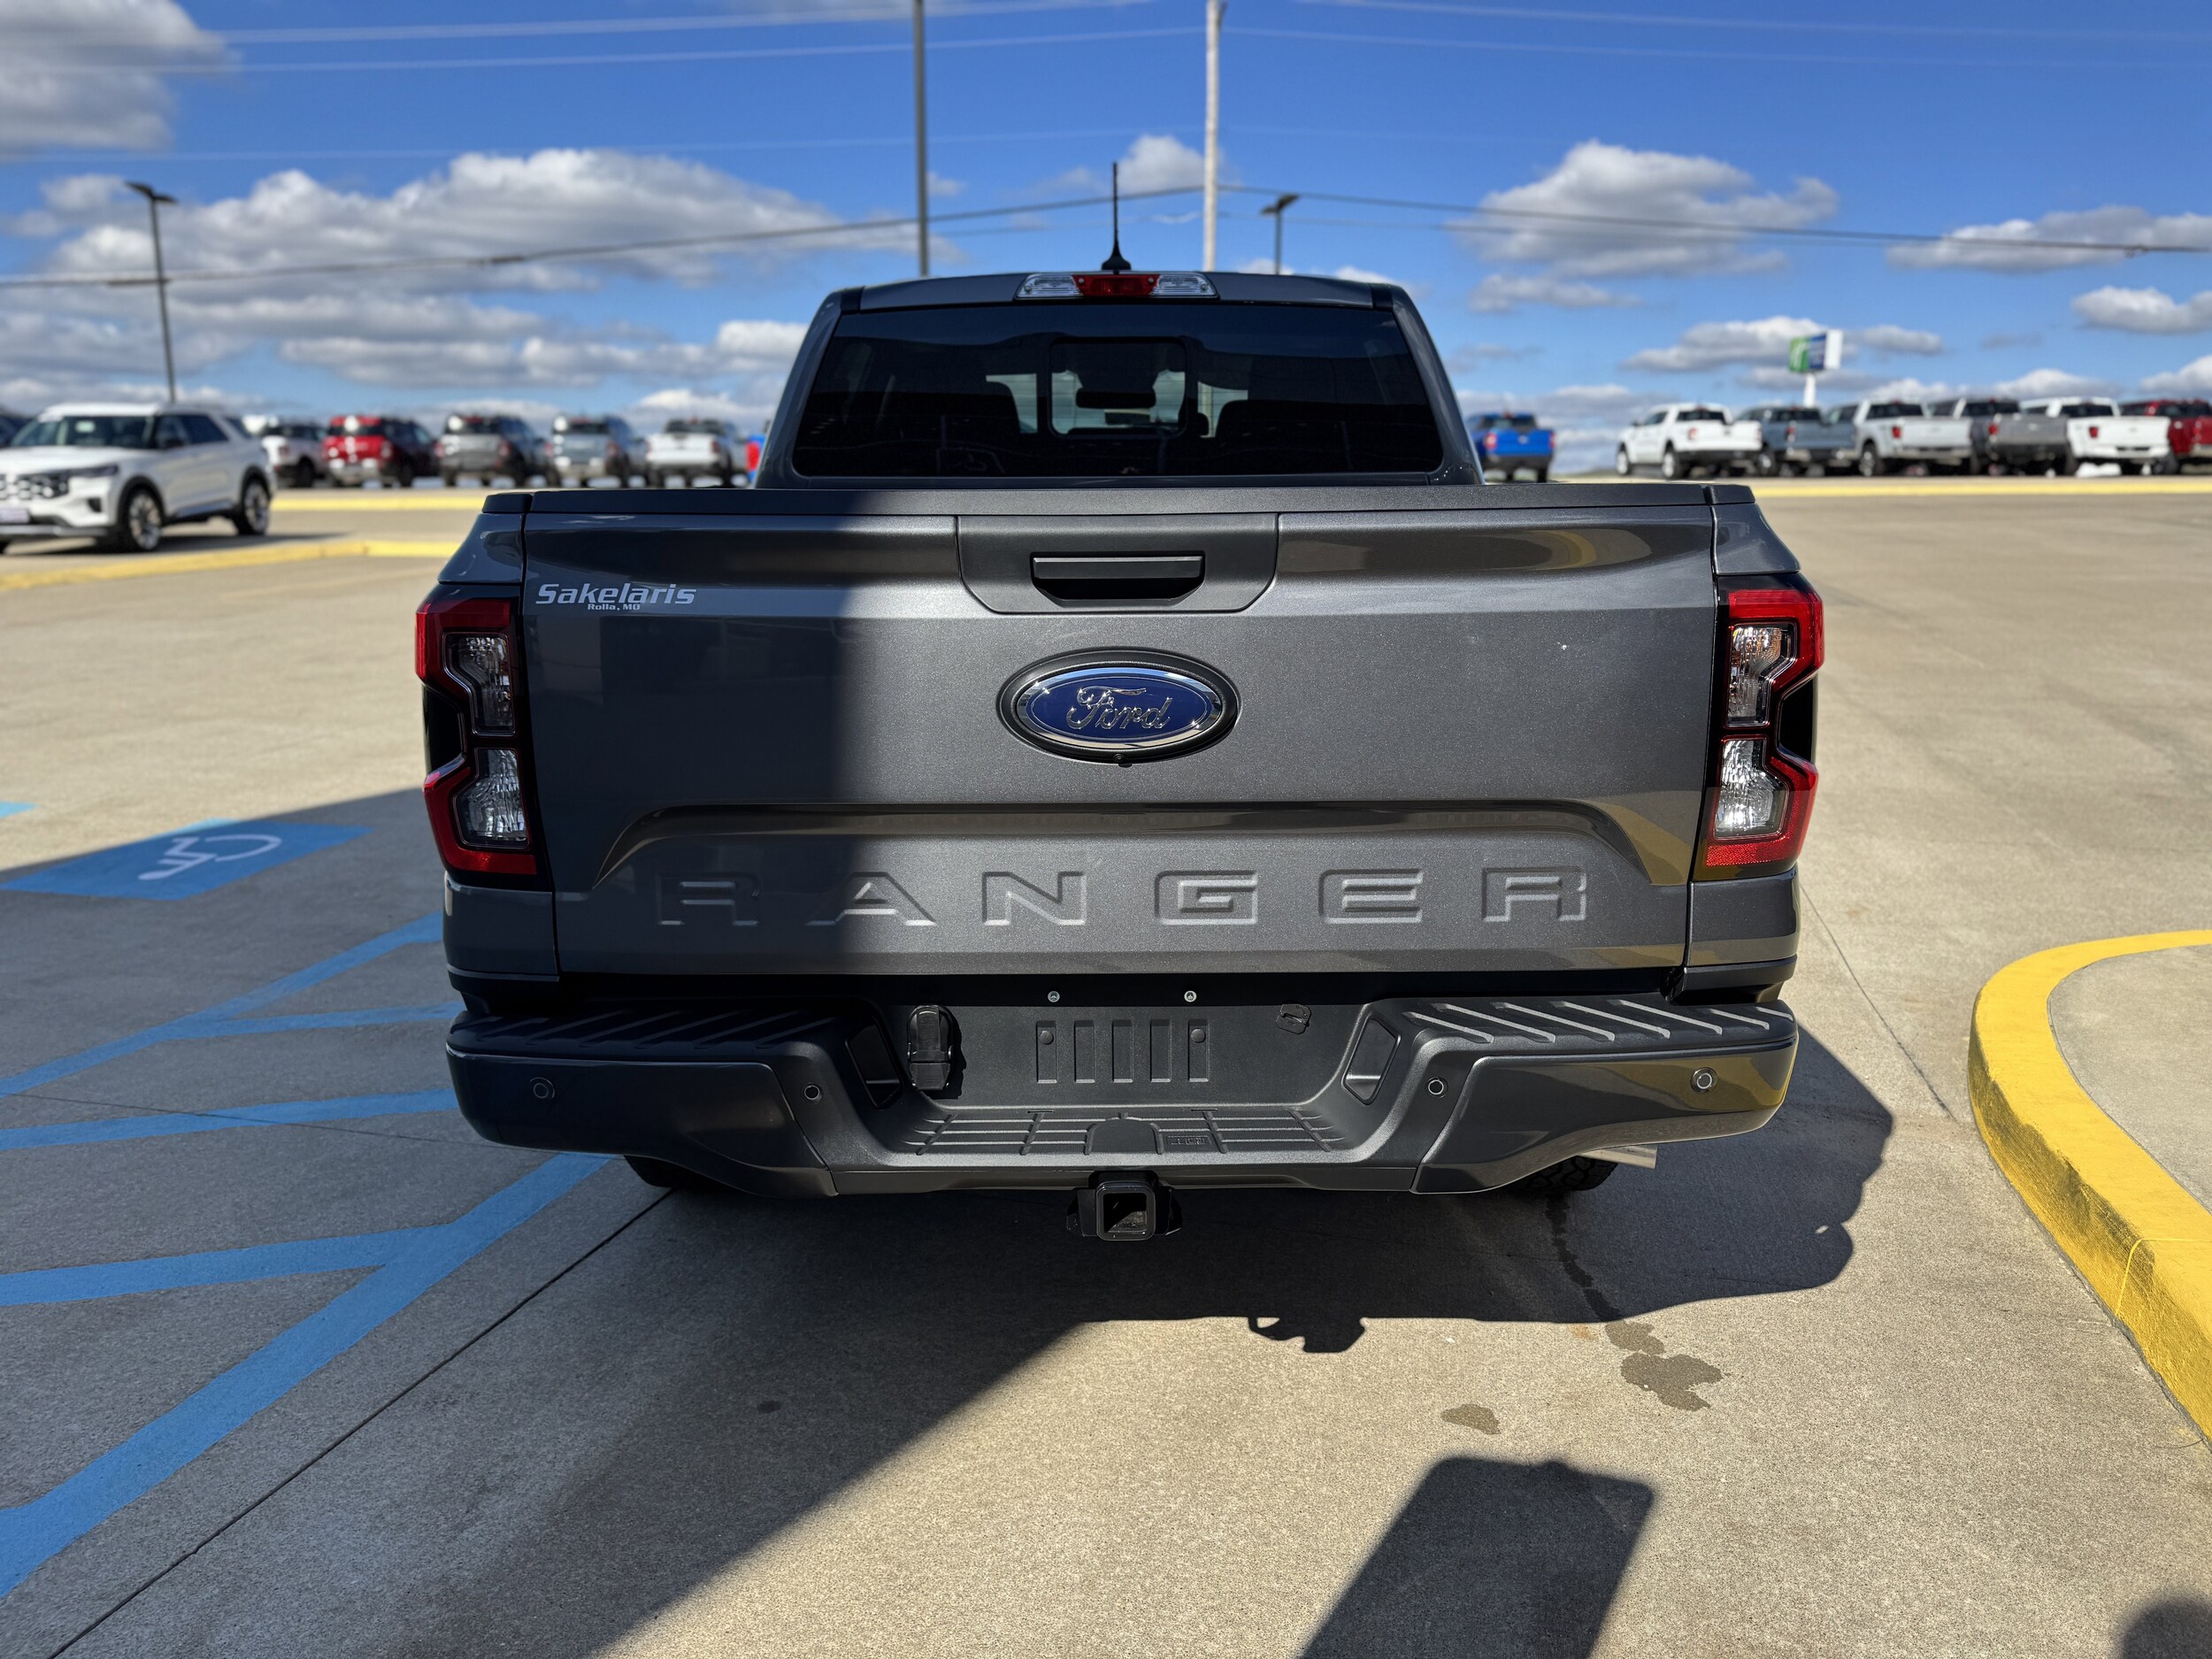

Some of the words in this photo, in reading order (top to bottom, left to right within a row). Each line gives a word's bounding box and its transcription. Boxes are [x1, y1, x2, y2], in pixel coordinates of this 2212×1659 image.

[535, 582, 697, 604] Sakelaris
[587, 603, 620, 611] Rolla,
[1065, 686, 1174, 730] Ford
[657, 866, 1588, 926] RANGER
